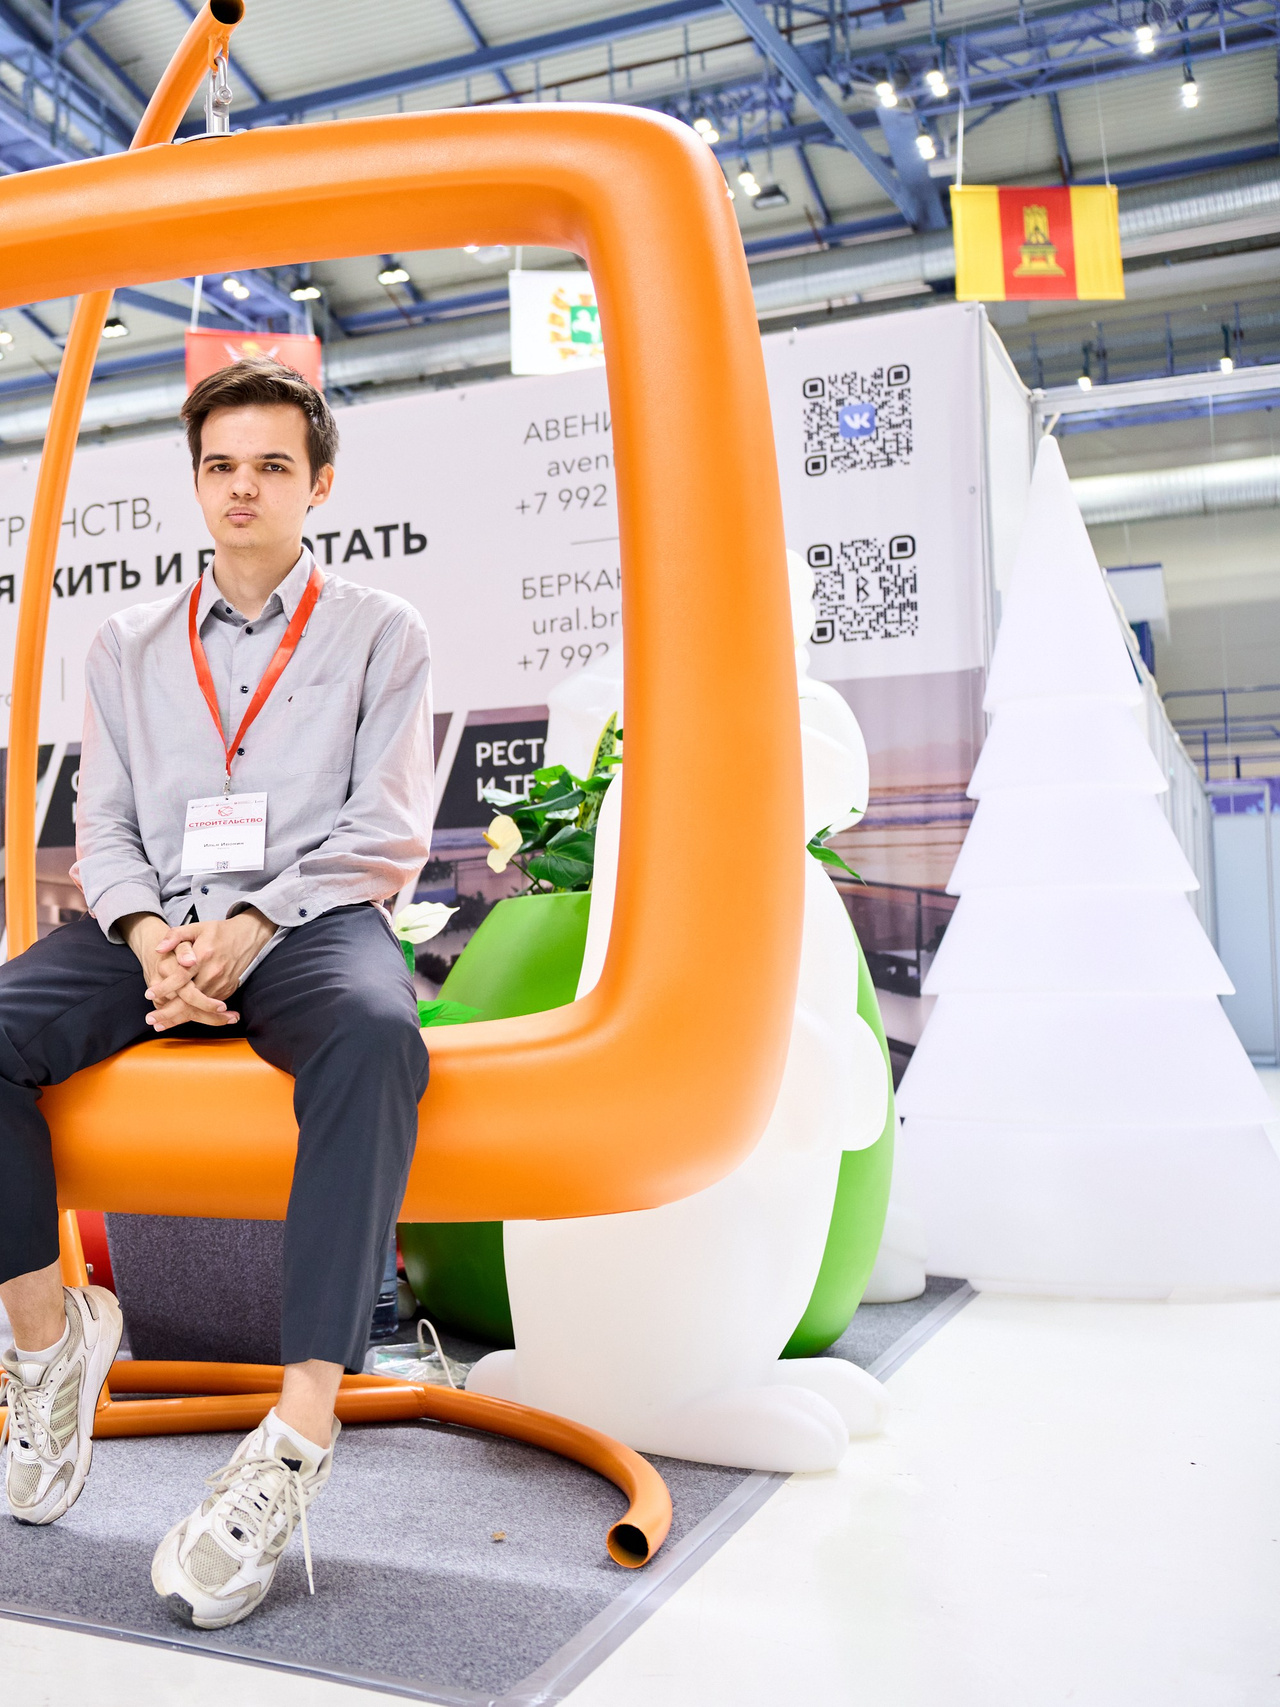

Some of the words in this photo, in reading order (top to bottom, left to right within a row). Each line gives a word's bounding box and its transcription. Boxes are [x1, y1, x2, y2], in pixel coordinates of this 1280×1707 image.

[547, 453, 609, 477] aven
[516, 492, 547, 515] +7
[558, 483, 607, 512] 992
[155, 552, 182, 586] И
[532, 605, 619, 635] ural.br
[517, 648, 549, 671] +7
[560, 642, 609, 669] 992
[476, 738, 544, 767] РЕСТ
[477, 776, 496, 802] И
[188, 817, 263, 828] СТРОИТЕЛЬСТВО
